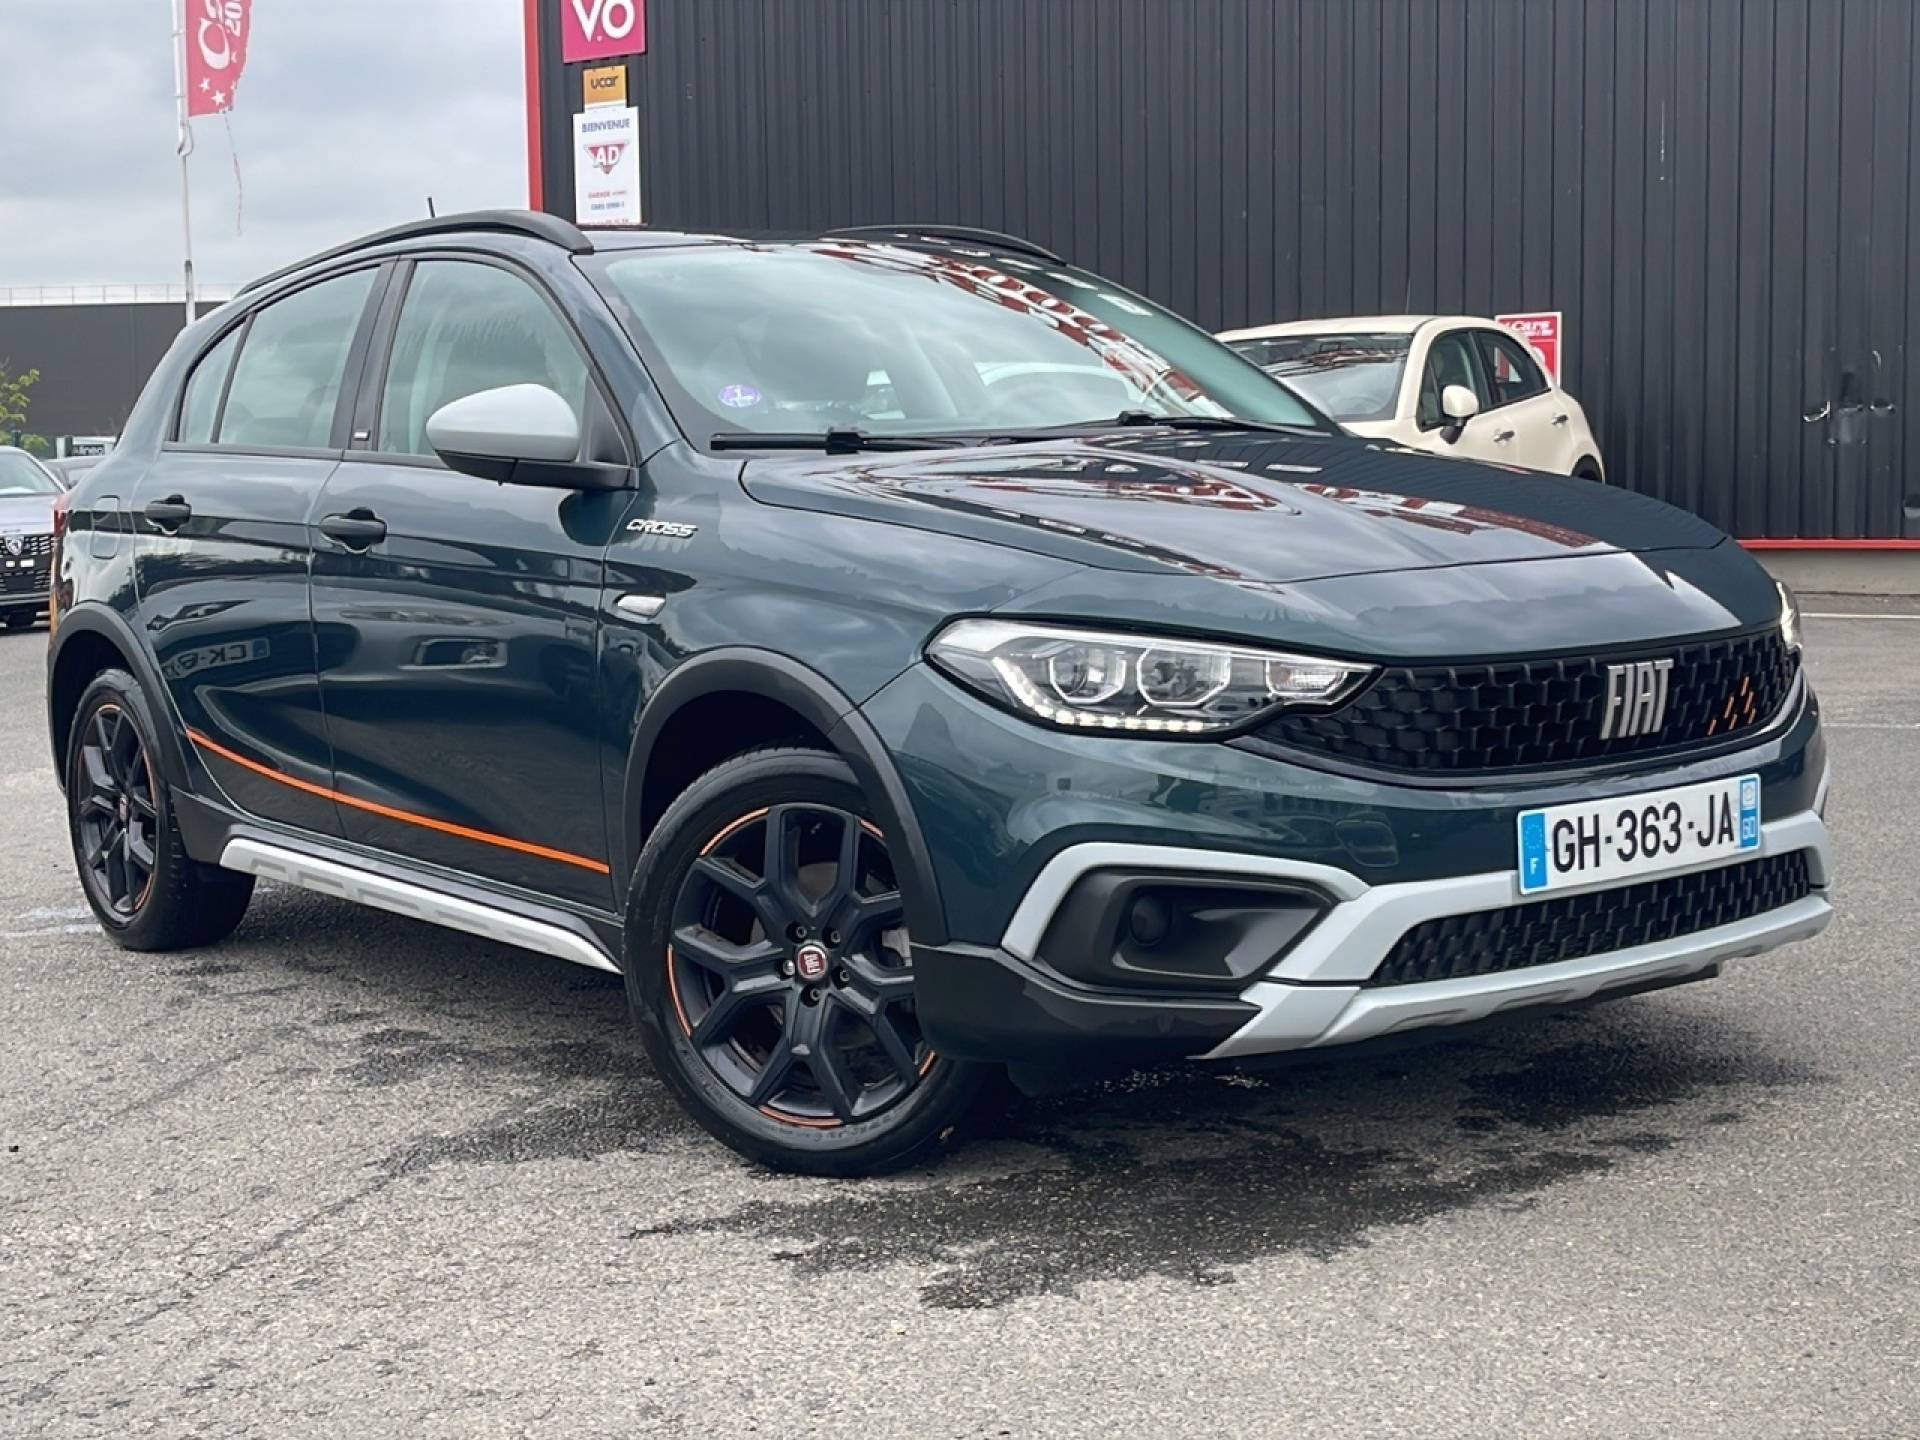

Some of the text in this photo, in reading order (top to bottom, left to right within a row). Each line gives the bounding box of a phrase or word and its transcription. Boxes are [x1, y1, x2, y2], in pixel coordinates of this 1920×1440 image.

[581, 118, 630, 133] BIENVENUE
[595, 145, 620, 166] AD
[626, 518, 698, 538] CROSS
[1600, 658, 1674, 740] FIAT
[1552, 791, 1735, 873] GH-363-JA
[1529, 857, 1538, 875] F
